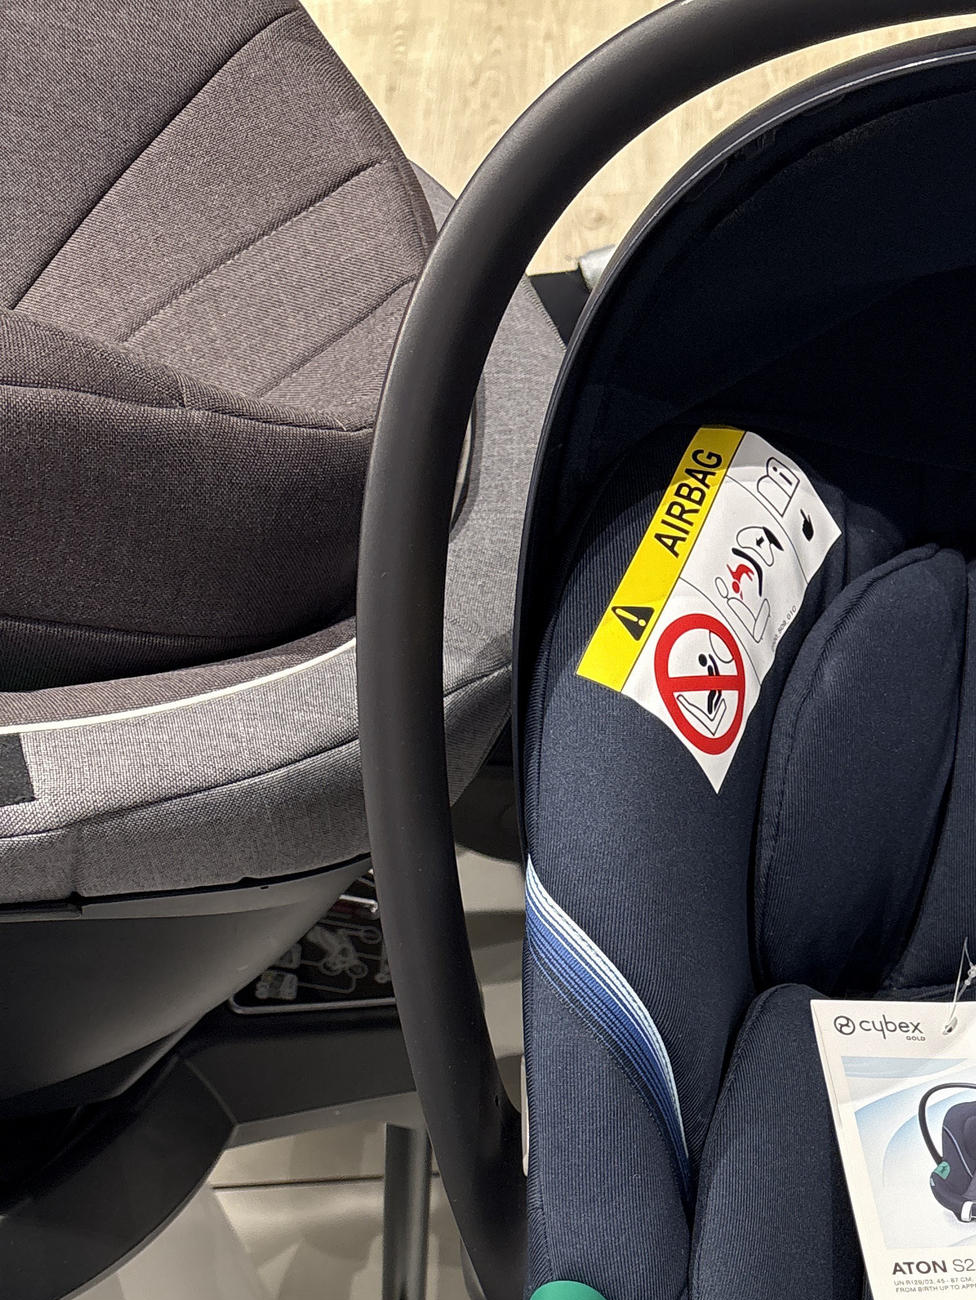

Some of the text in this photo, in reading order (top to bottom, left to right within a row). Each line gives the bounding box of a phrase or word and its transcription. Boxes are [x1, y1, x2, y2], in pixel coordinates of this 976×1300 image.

[653, 448, 723, 558] AIRBAG
[859, 1014, 923, 1040] cybex
[892, 1259, 948, 1275] ATON
[952, 1258, 976, 1272] S2
